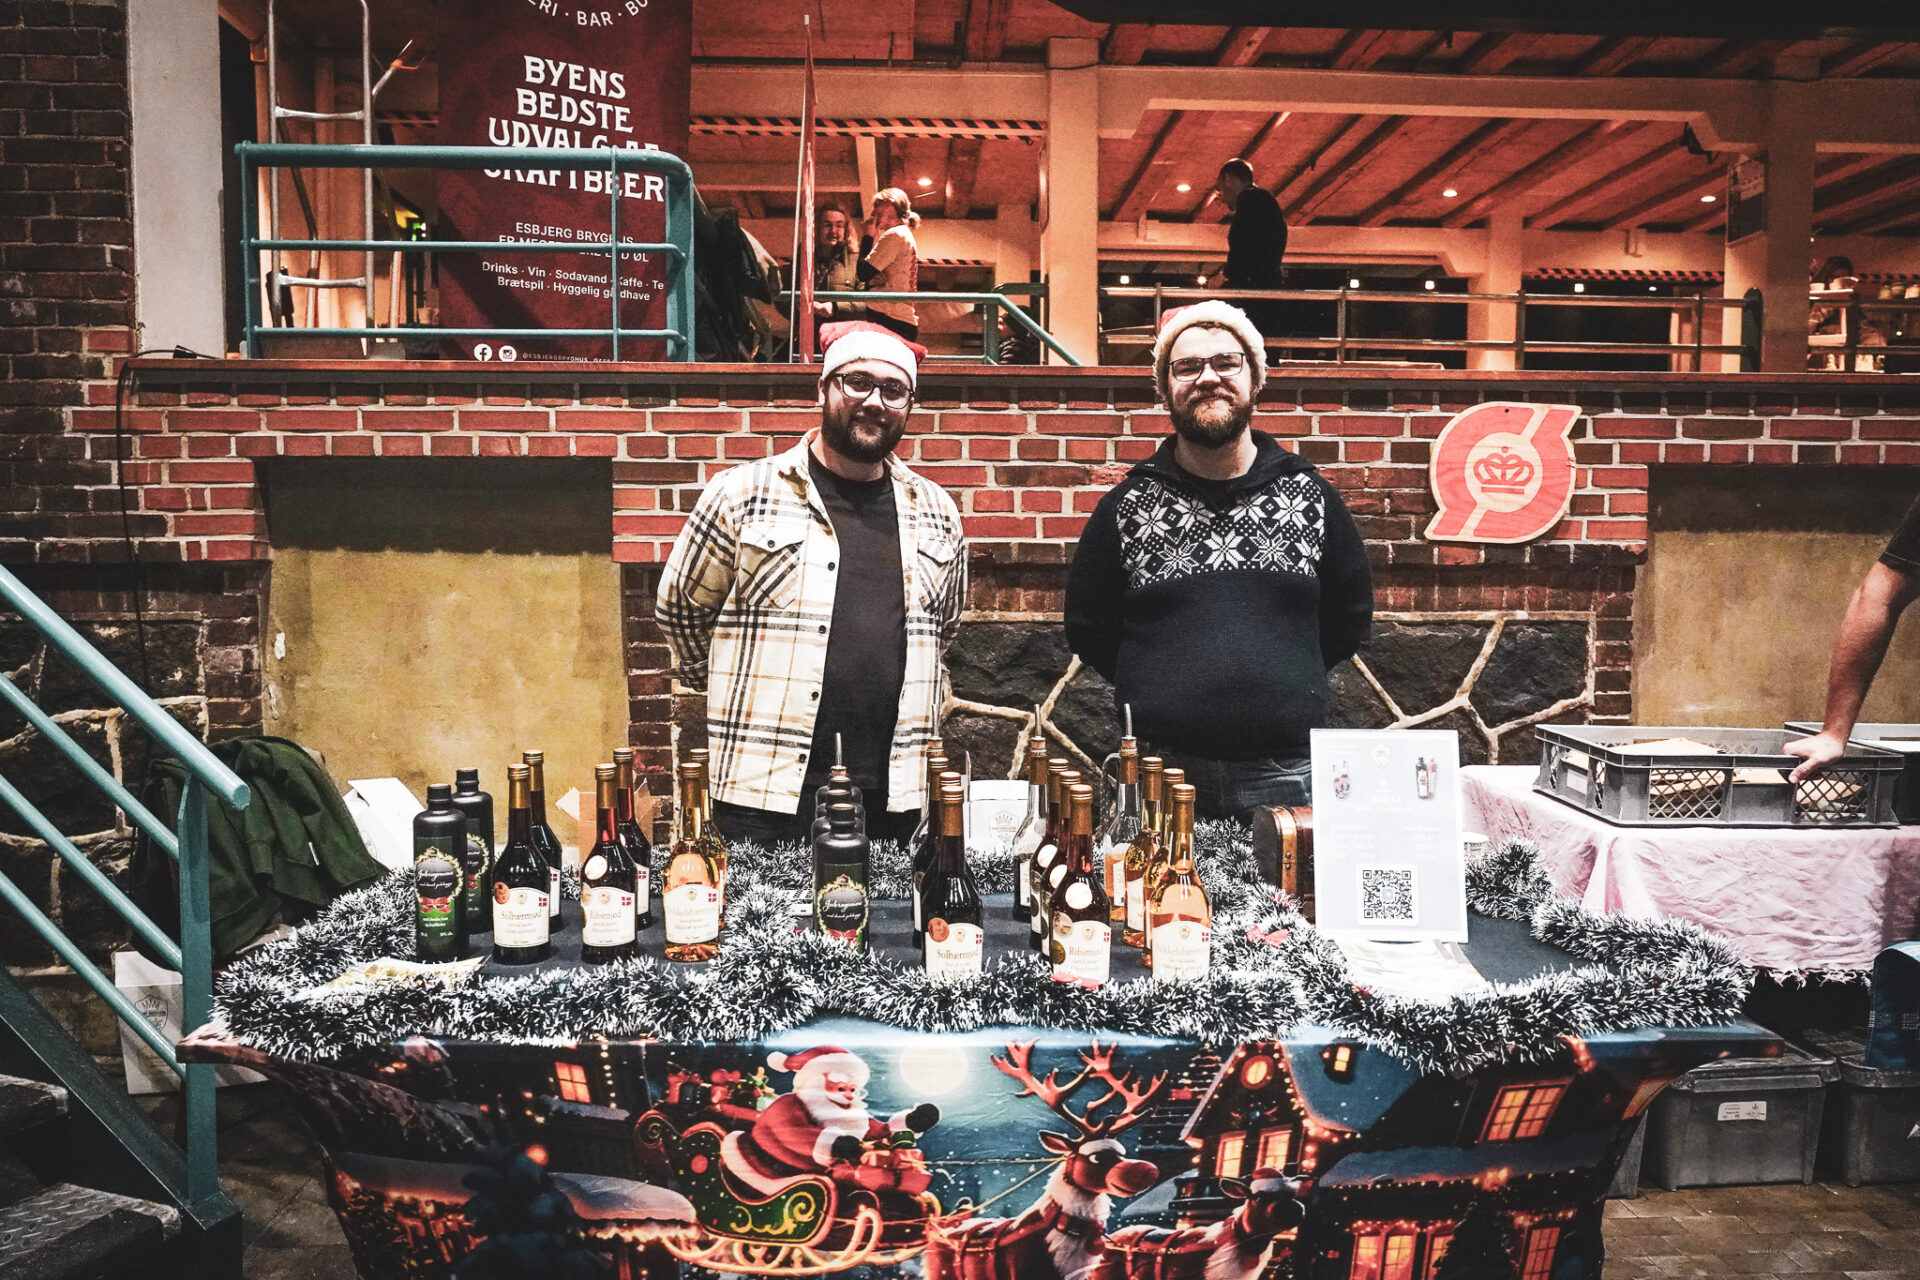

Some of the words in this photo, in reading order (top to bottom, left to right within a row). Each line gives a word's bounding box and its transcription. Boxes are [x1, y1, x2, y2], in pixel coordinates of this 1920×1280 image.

[576, 10, 613, 27] BAR
[523, 55, 626, 99] BYENS
[516, 87, 634, 133] BEDSTE
[515, 222, 573, 239] ESBJERG
[482, 261, 518, 275] Drinks
[527, 265, 546, 278] Vin
[555, 269, 607, 285] Sodavand
[652, 279, 665, 291] Te
[497, 276, 544, 293] Brætspil
[553, 282, 600, 299] Hyggelig
[603, 287, 651, 302] gådhave
